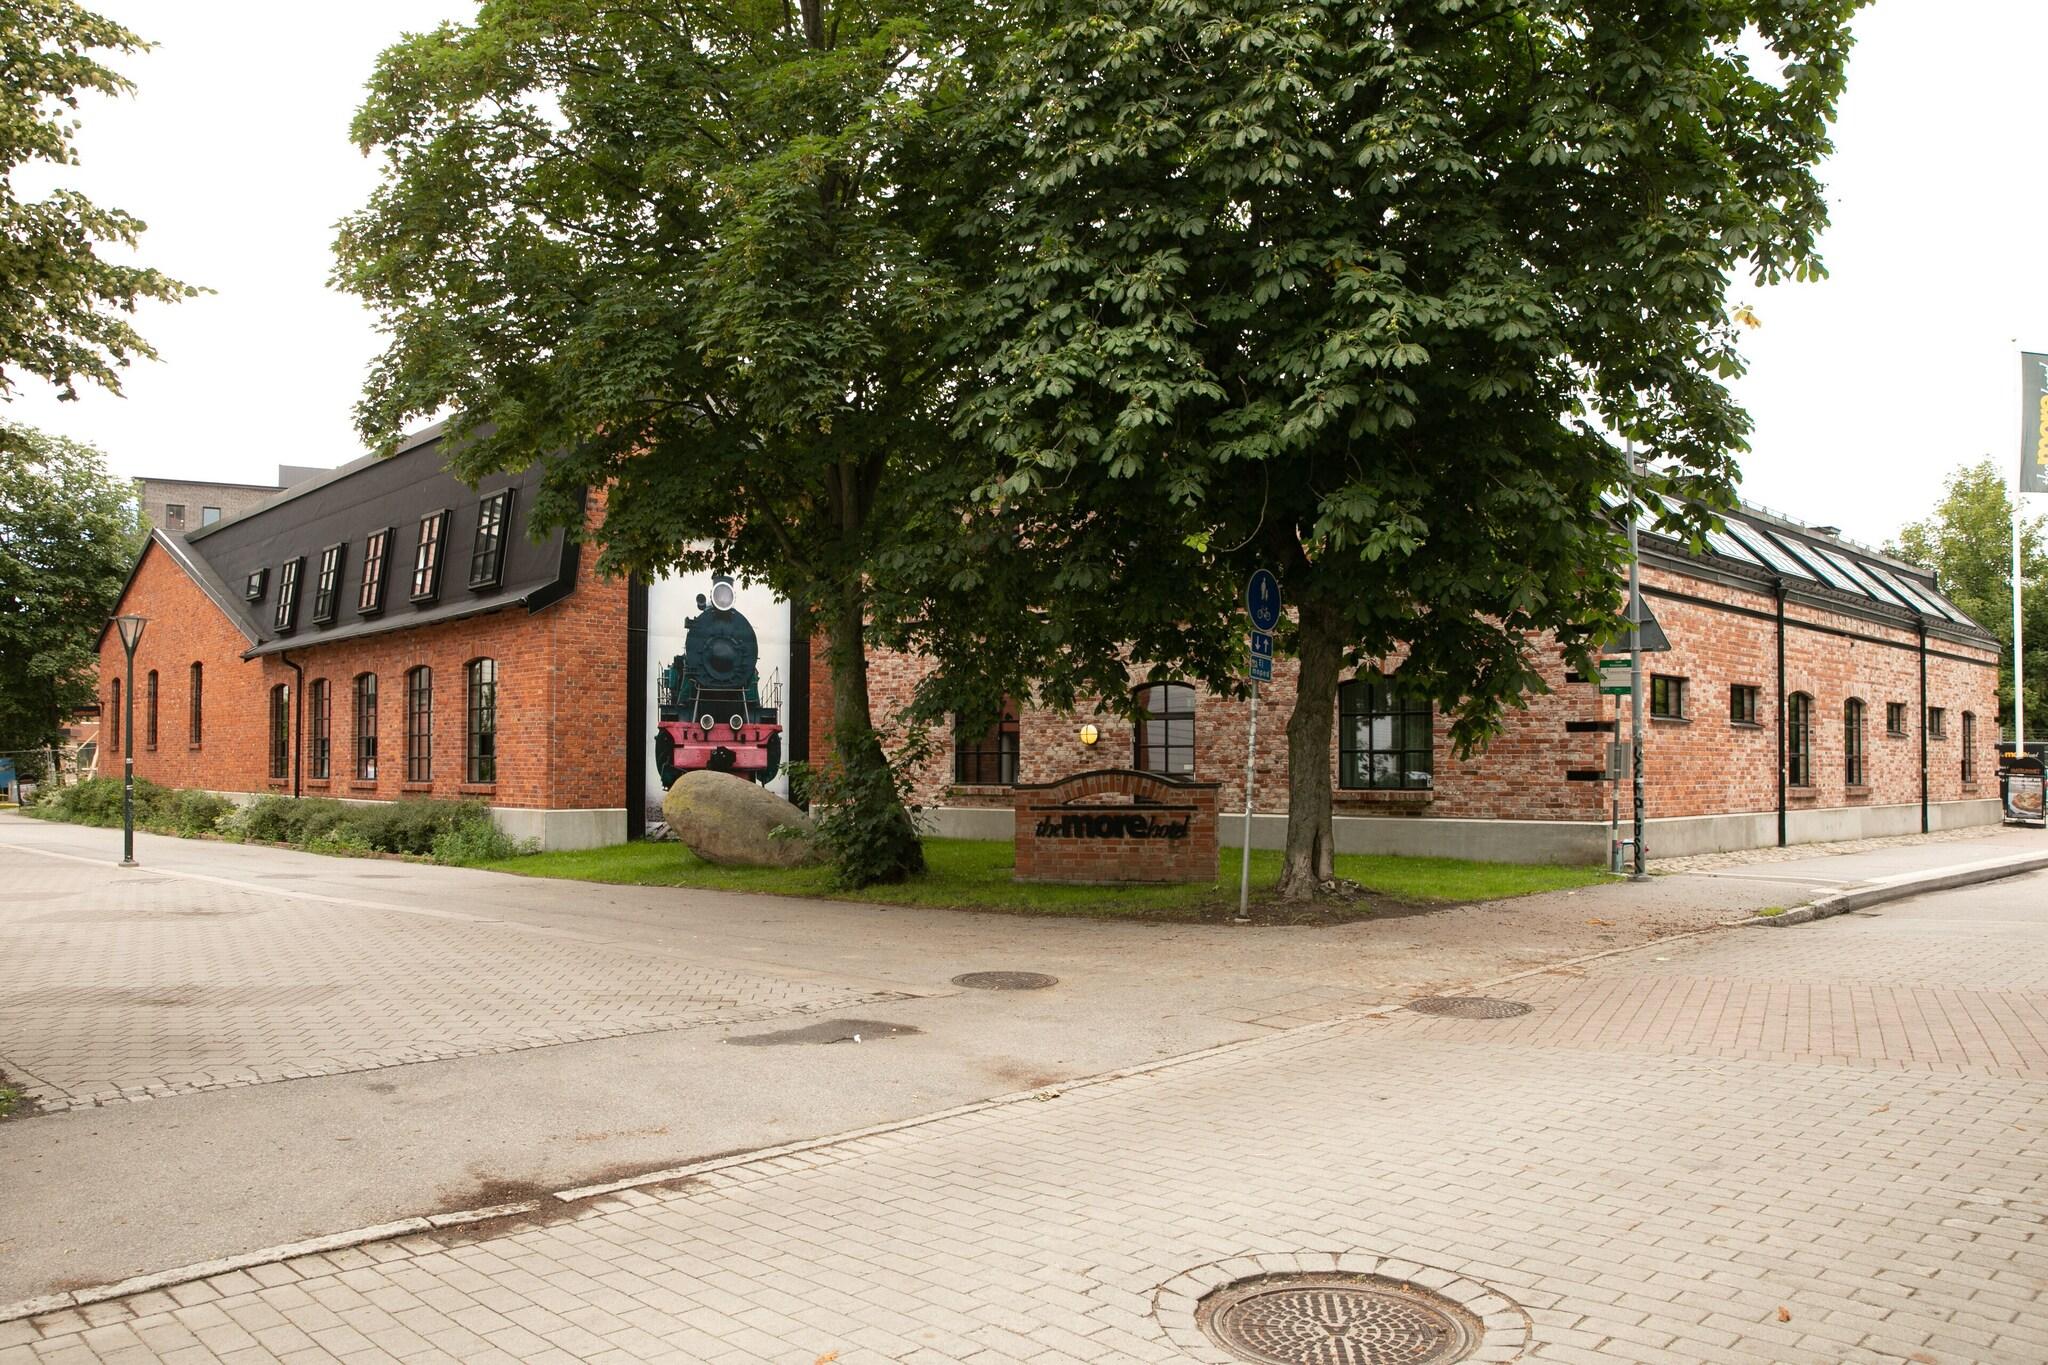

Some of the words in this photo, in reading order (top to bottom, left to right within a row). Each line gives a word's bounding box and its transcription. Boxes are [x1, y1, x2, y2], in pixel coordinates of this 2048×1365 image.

[1036, 815, 1061, 838] the
[1062, 815, 1147, 838] more
[1146, 815, 1189, 839] hotel
